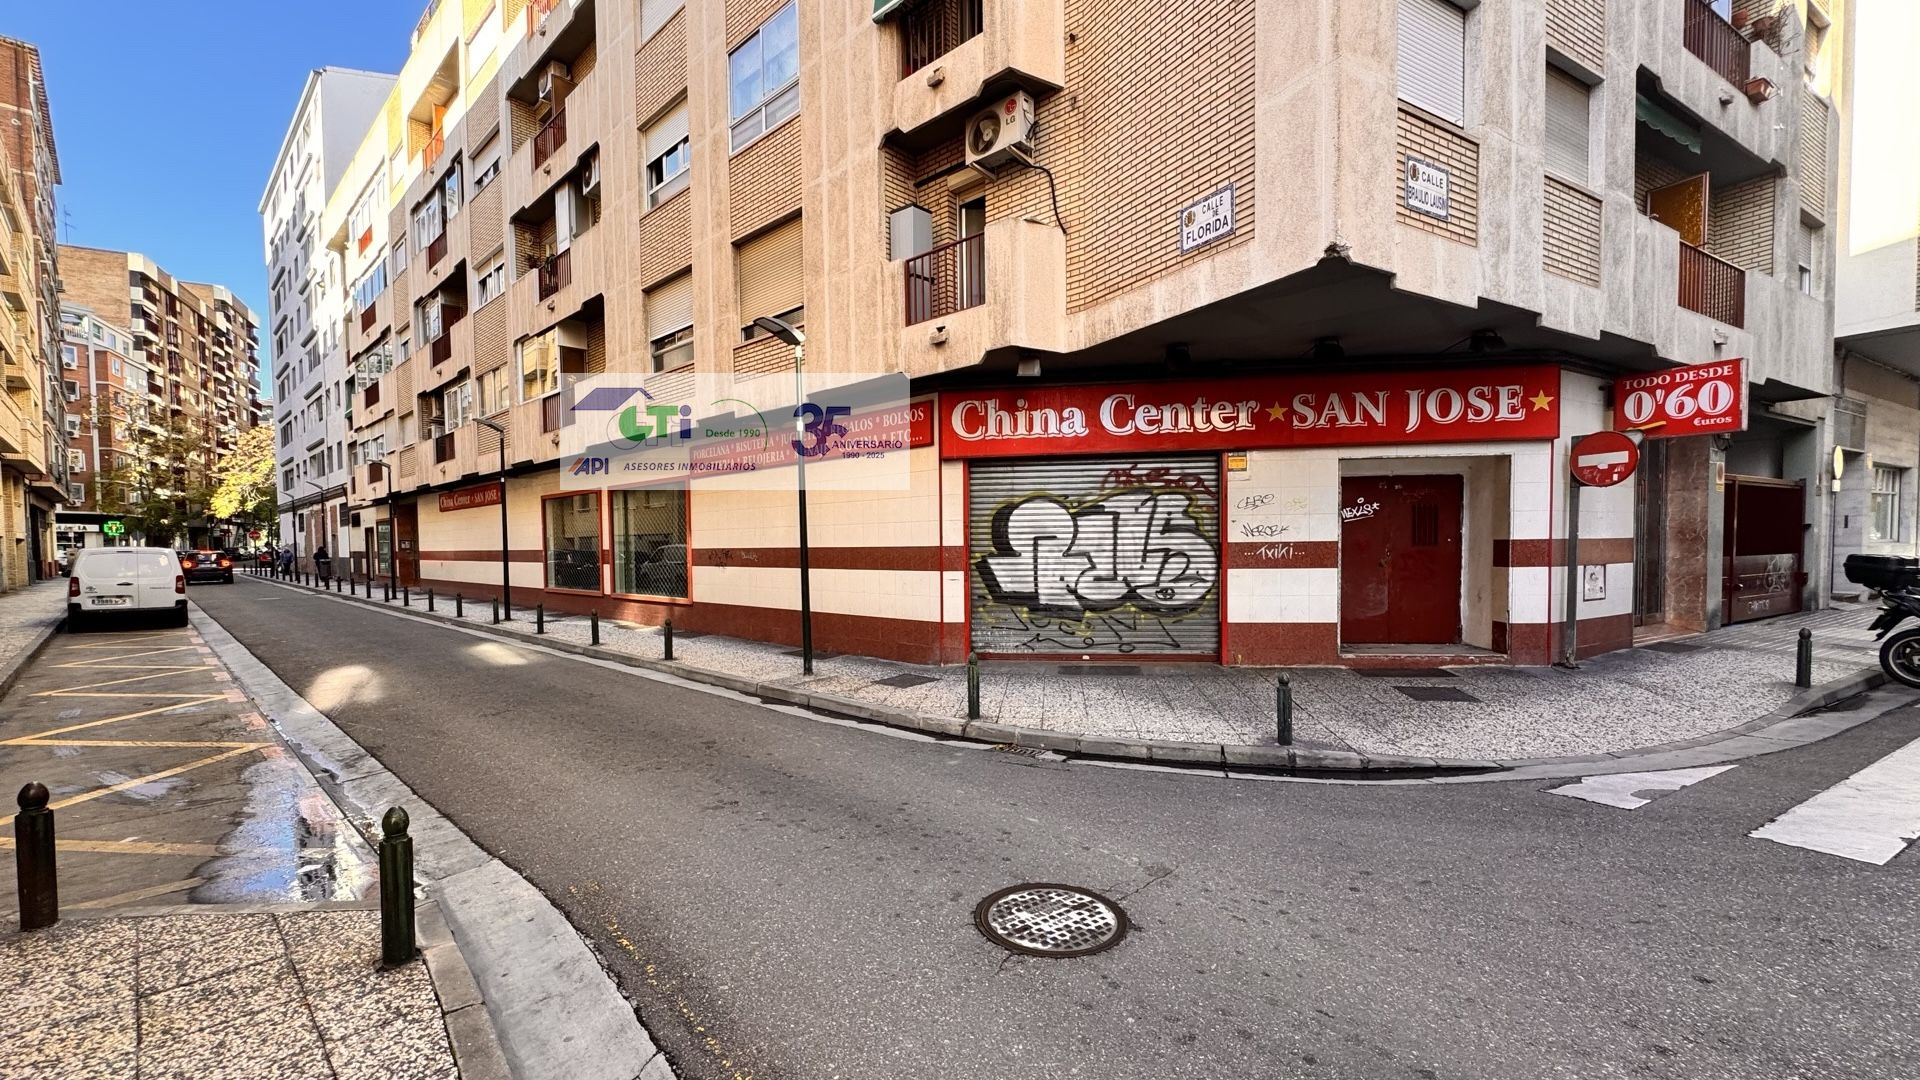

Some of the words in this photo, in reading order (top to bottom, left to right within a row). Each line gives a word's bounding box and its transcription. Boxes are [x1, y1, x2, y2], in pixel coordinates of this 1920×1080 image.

[1005, 115, 1016, 126] LG
[1421, 171, 1444, 189] CALLE
[1201, 195, 1224, 215] CALLE
[1212, 208, 1219, 218] DE
[1186, 214, 1229, 245] FLORIDA
[1623, 374, 1671, 390] TODO
[1675, 364, 1733, 383] DESDE
[951, 398, 1088, 441] China
[1100, 393, 1260, 433] Center
[1292, 390, 1390, 429] SAN
[1405, 384, 1526, 433] JOSE
[1623, 380, 1734, 424] 0'60
[693, 444, 730, 460] PORCELANA
[883, 407, 924, 427] BOLSOS
[742, 450, 785, 466] RELOJERIA
